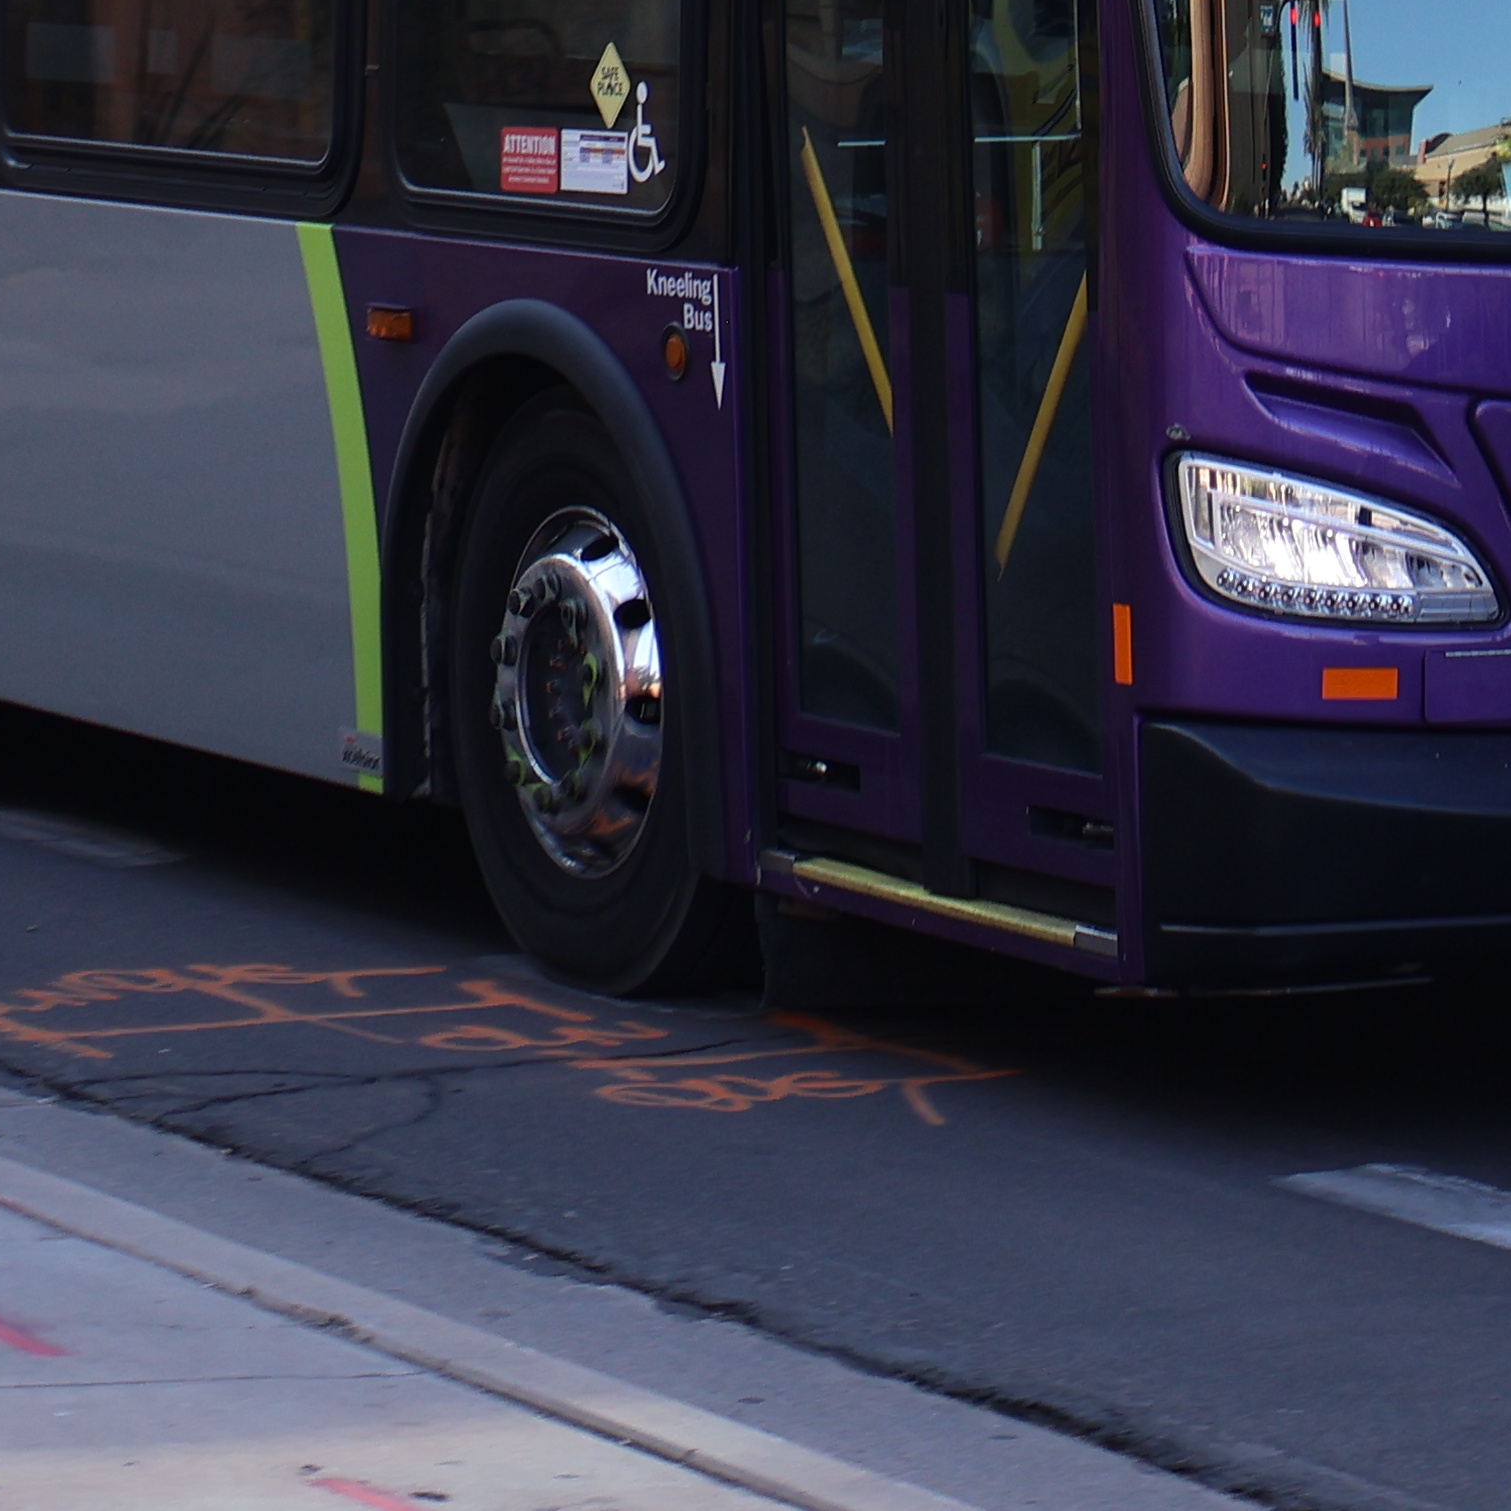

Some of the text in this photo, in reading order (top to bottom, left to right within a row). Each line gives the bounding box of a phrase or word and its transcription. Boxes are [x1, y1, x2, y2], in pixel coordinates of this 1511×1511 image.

[503, 135, 556, 155] ATTENTION
[646, 268, 713, 306] Kneeling
[683, 303, 713, 332] Bus
